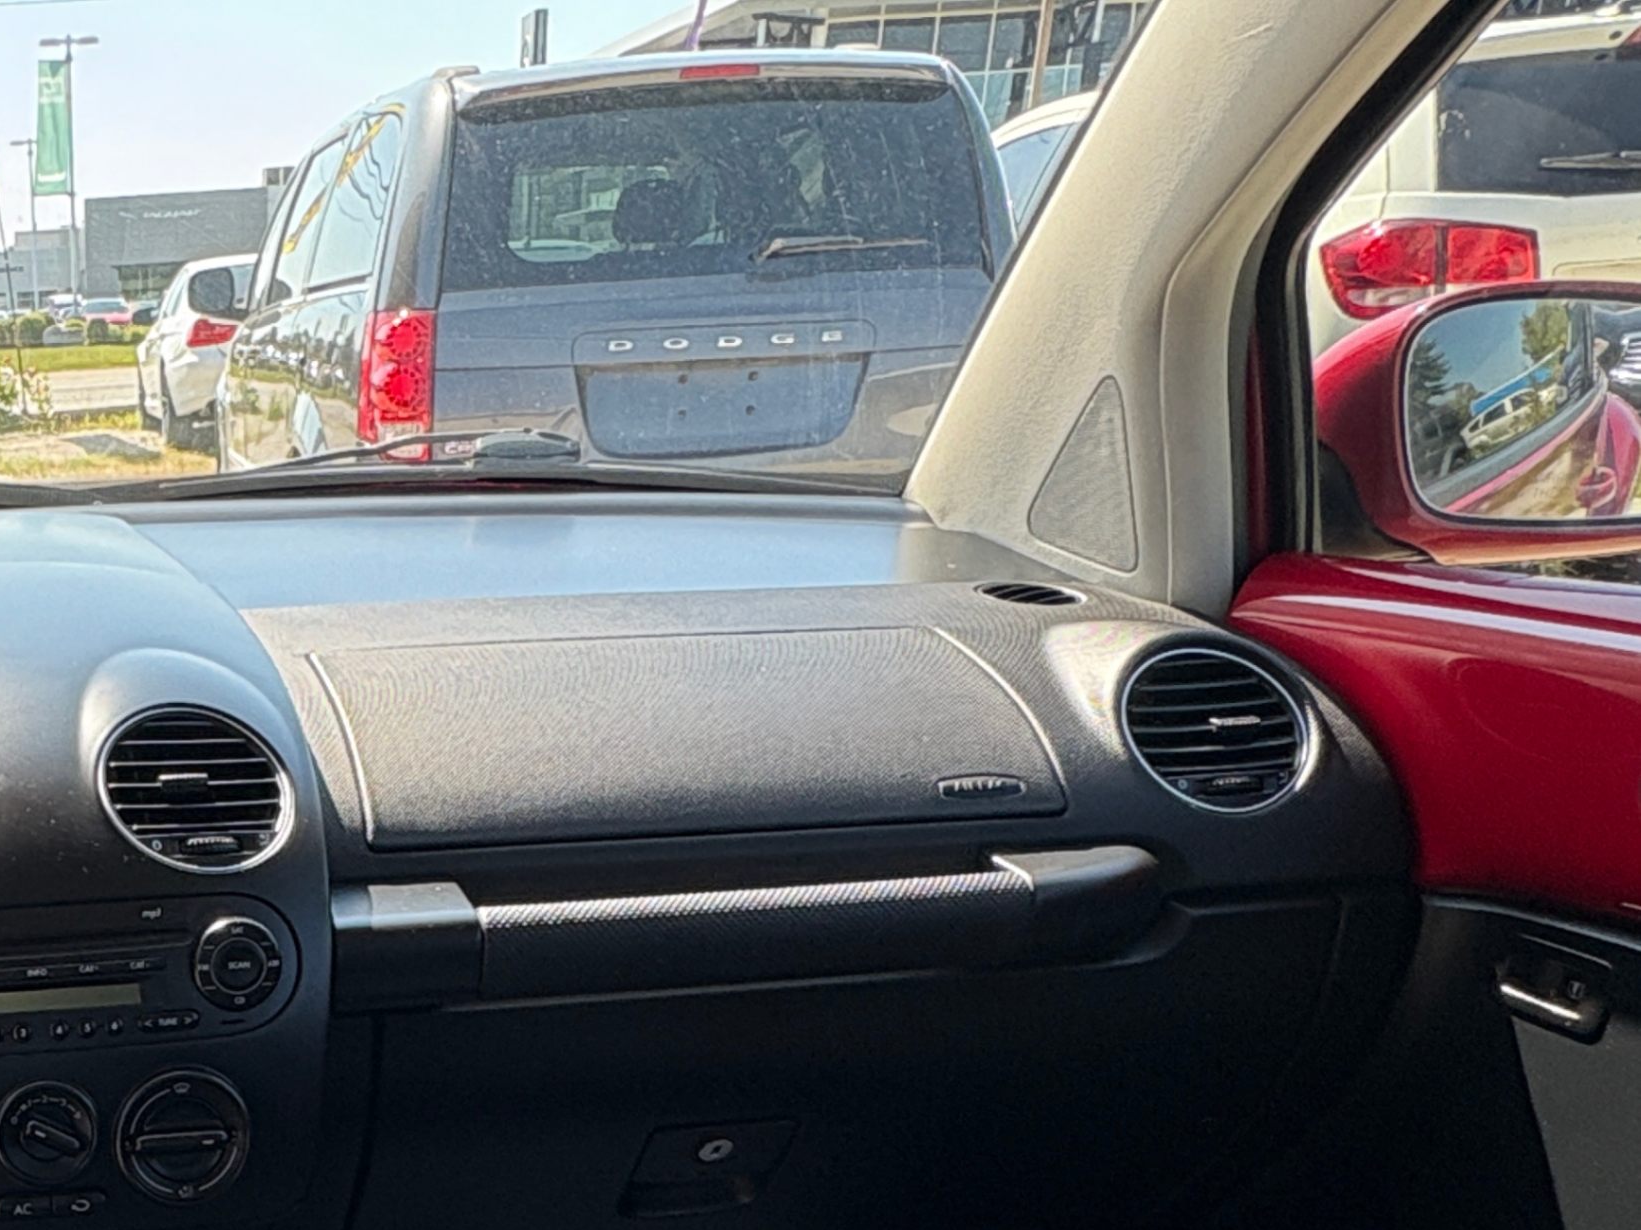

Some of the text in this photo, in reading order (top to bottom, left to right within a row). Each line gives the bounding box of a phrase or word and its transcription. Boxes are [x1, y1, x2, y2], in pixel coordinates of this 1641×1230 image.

[607, 330, 843, 353] DODGE
[227, 961, 251, 970] SCAN
[13, 1202, 34, 1216] AC
